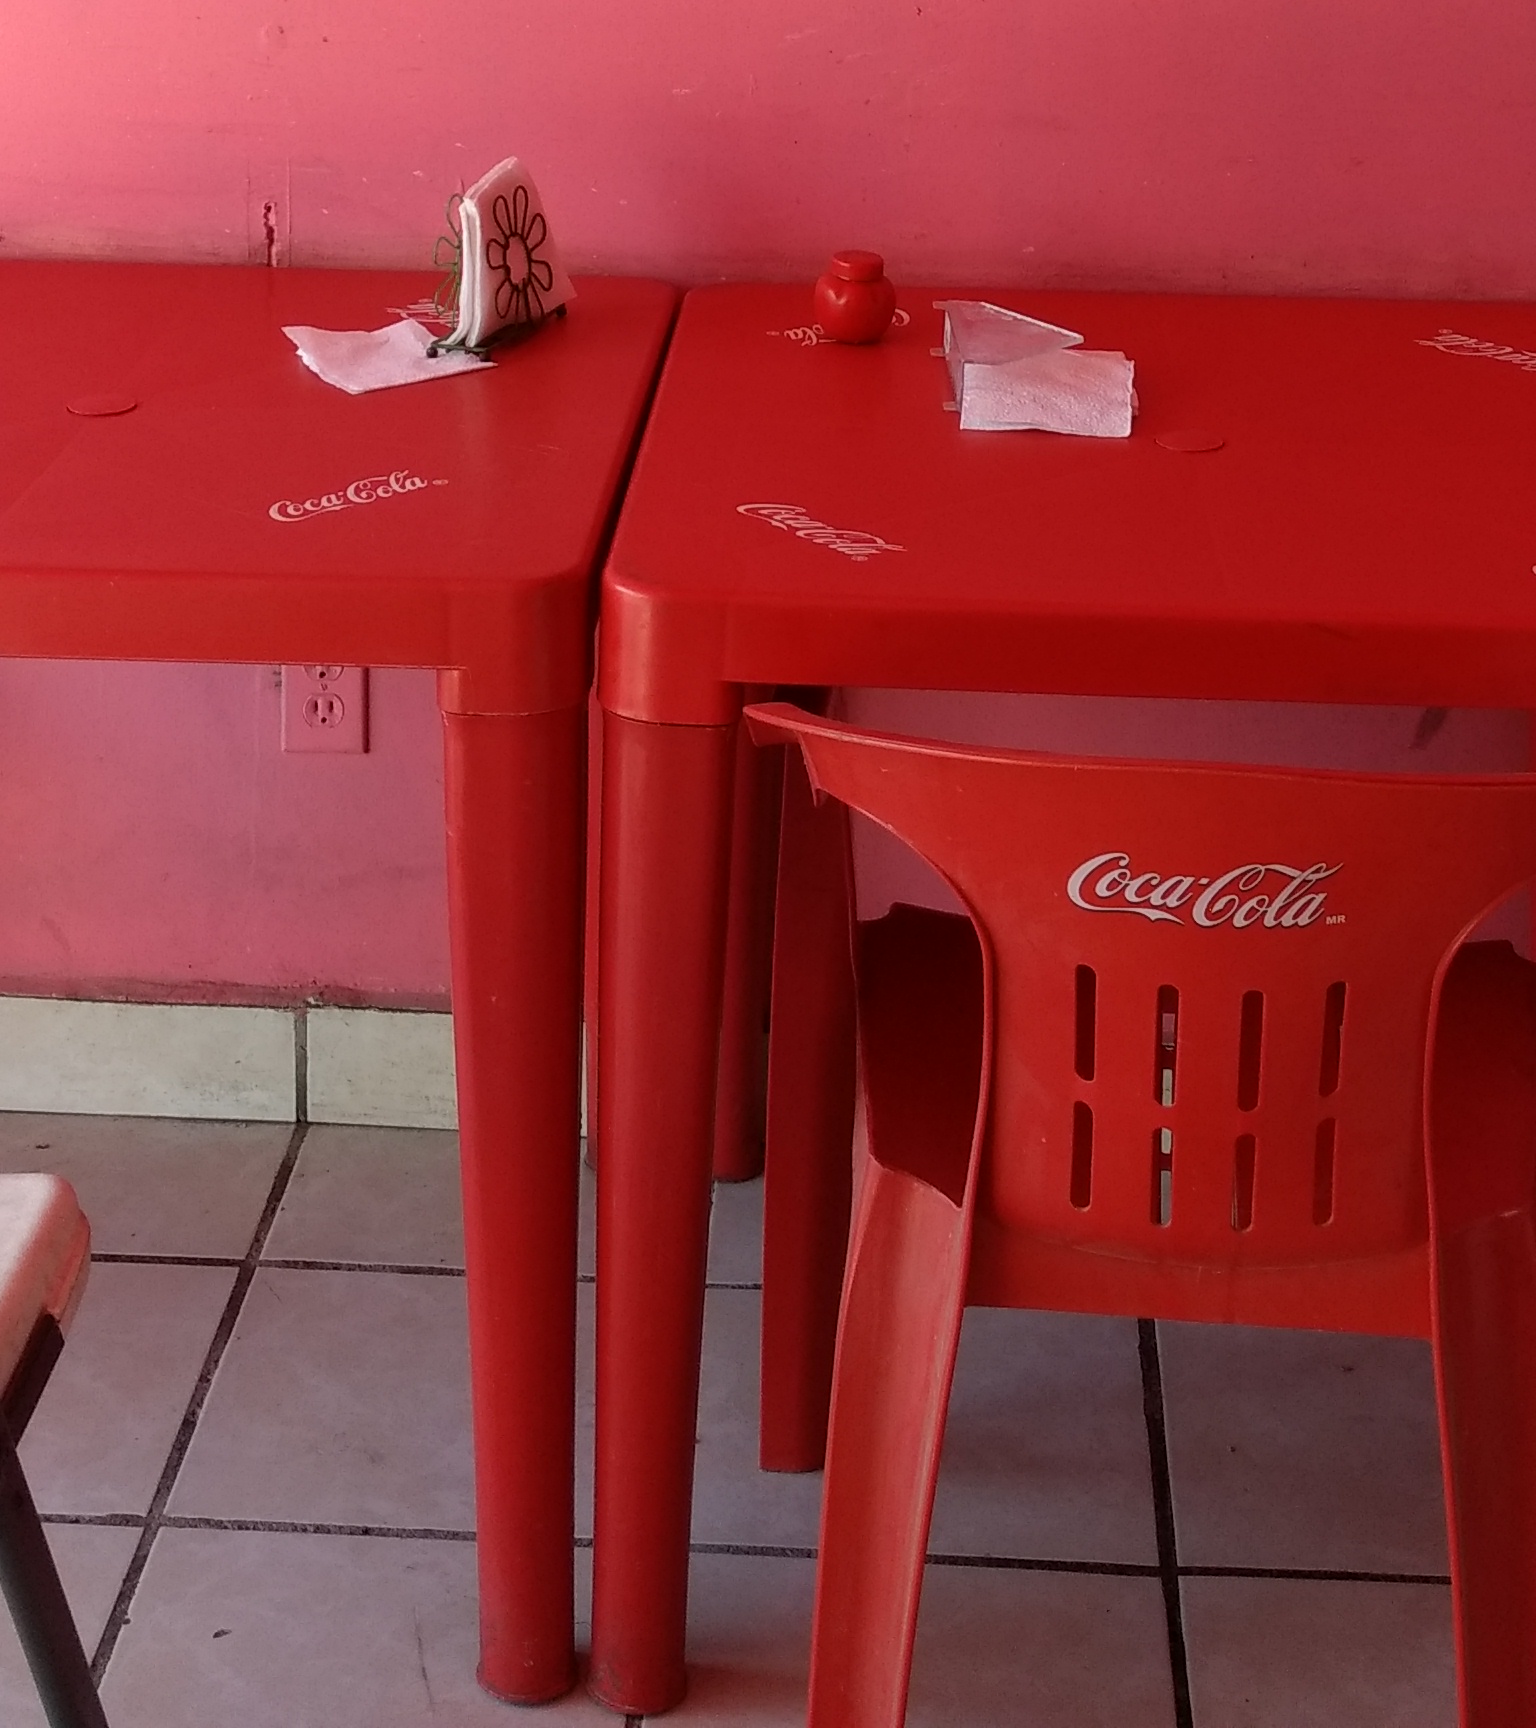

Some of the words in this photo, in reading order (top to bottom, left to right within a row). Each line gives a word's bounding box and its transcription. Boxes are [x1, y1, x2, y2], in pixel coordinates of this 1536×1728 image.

[268, 469, 428, 523] Coca-Cola
[1066, 851, 1344, 929] Coca-Cola
[1325, 914, 1347, 925] MR
